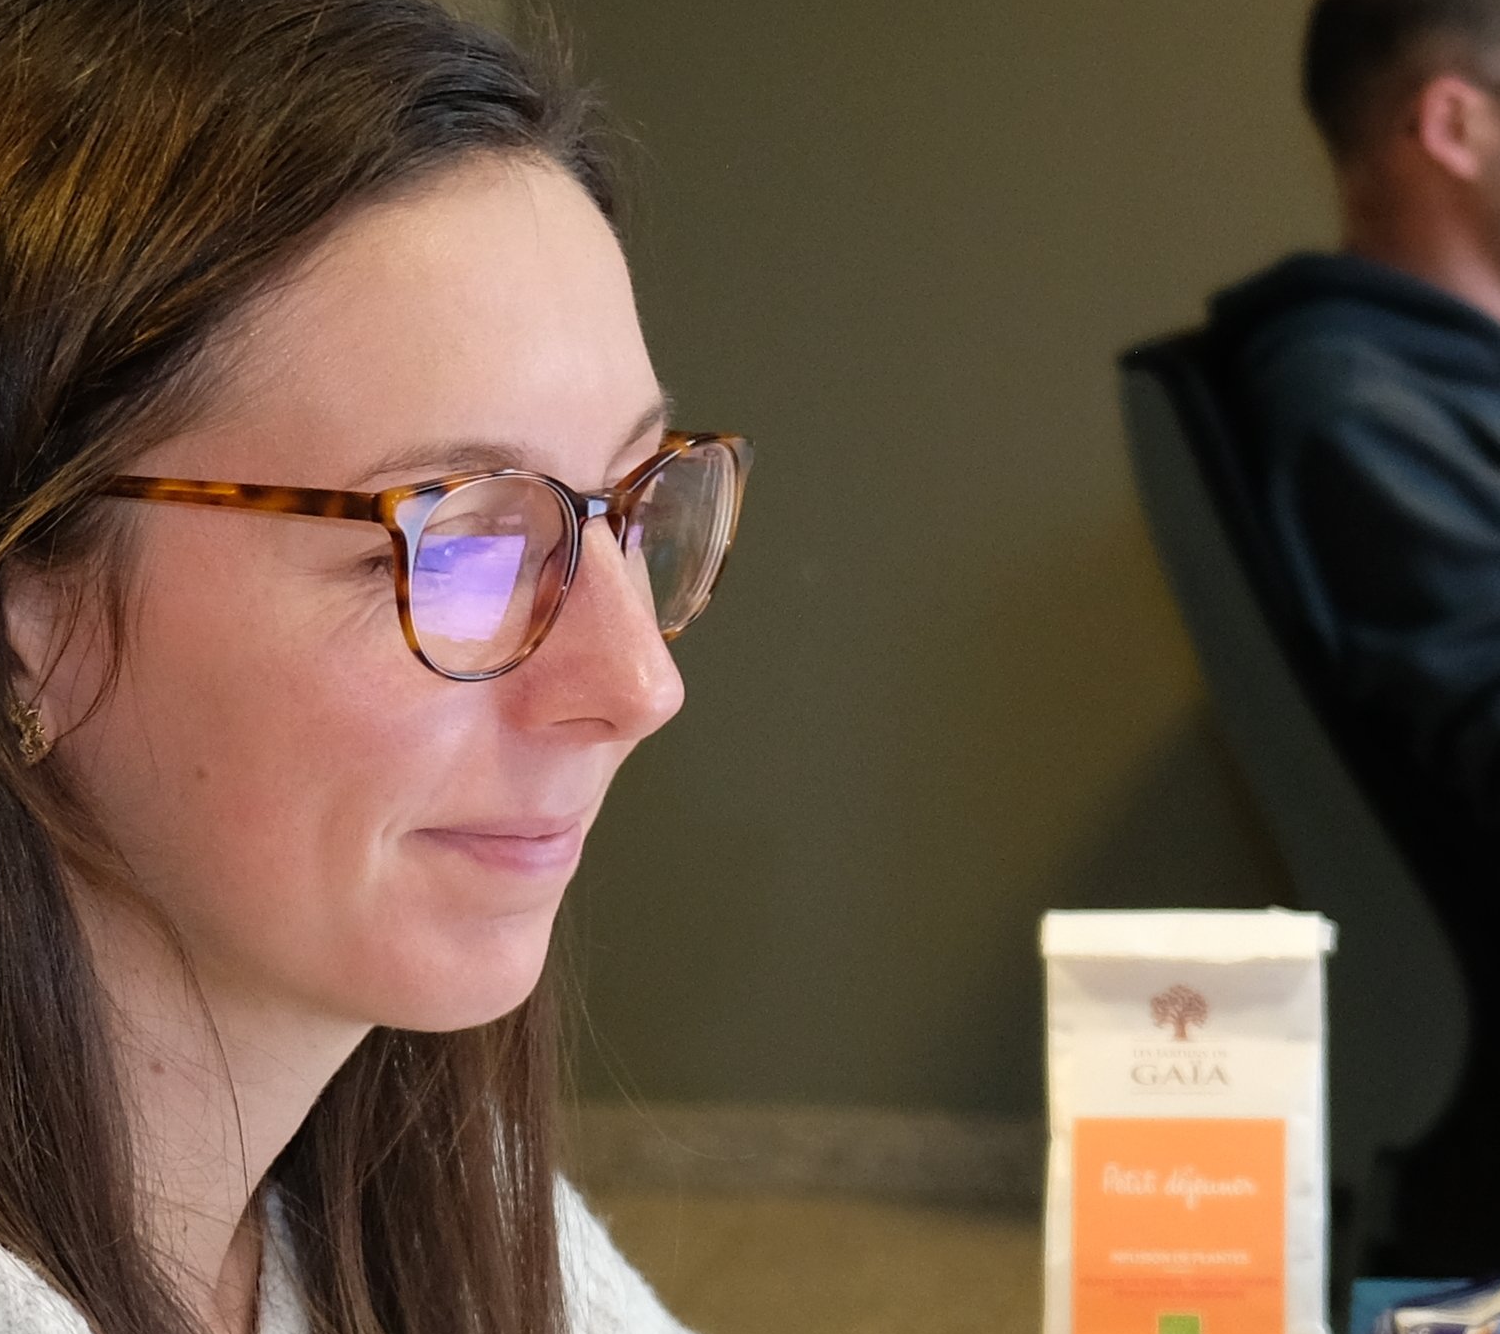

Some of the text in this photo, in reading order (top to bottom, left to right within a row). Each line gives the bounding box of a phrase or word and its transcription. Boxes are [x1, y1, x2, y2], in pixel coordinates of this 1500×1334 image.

[1130, 1060, 1230, 1087] GAÏA
[1103, 1163, 1256, 1210] Petit déjeuner
